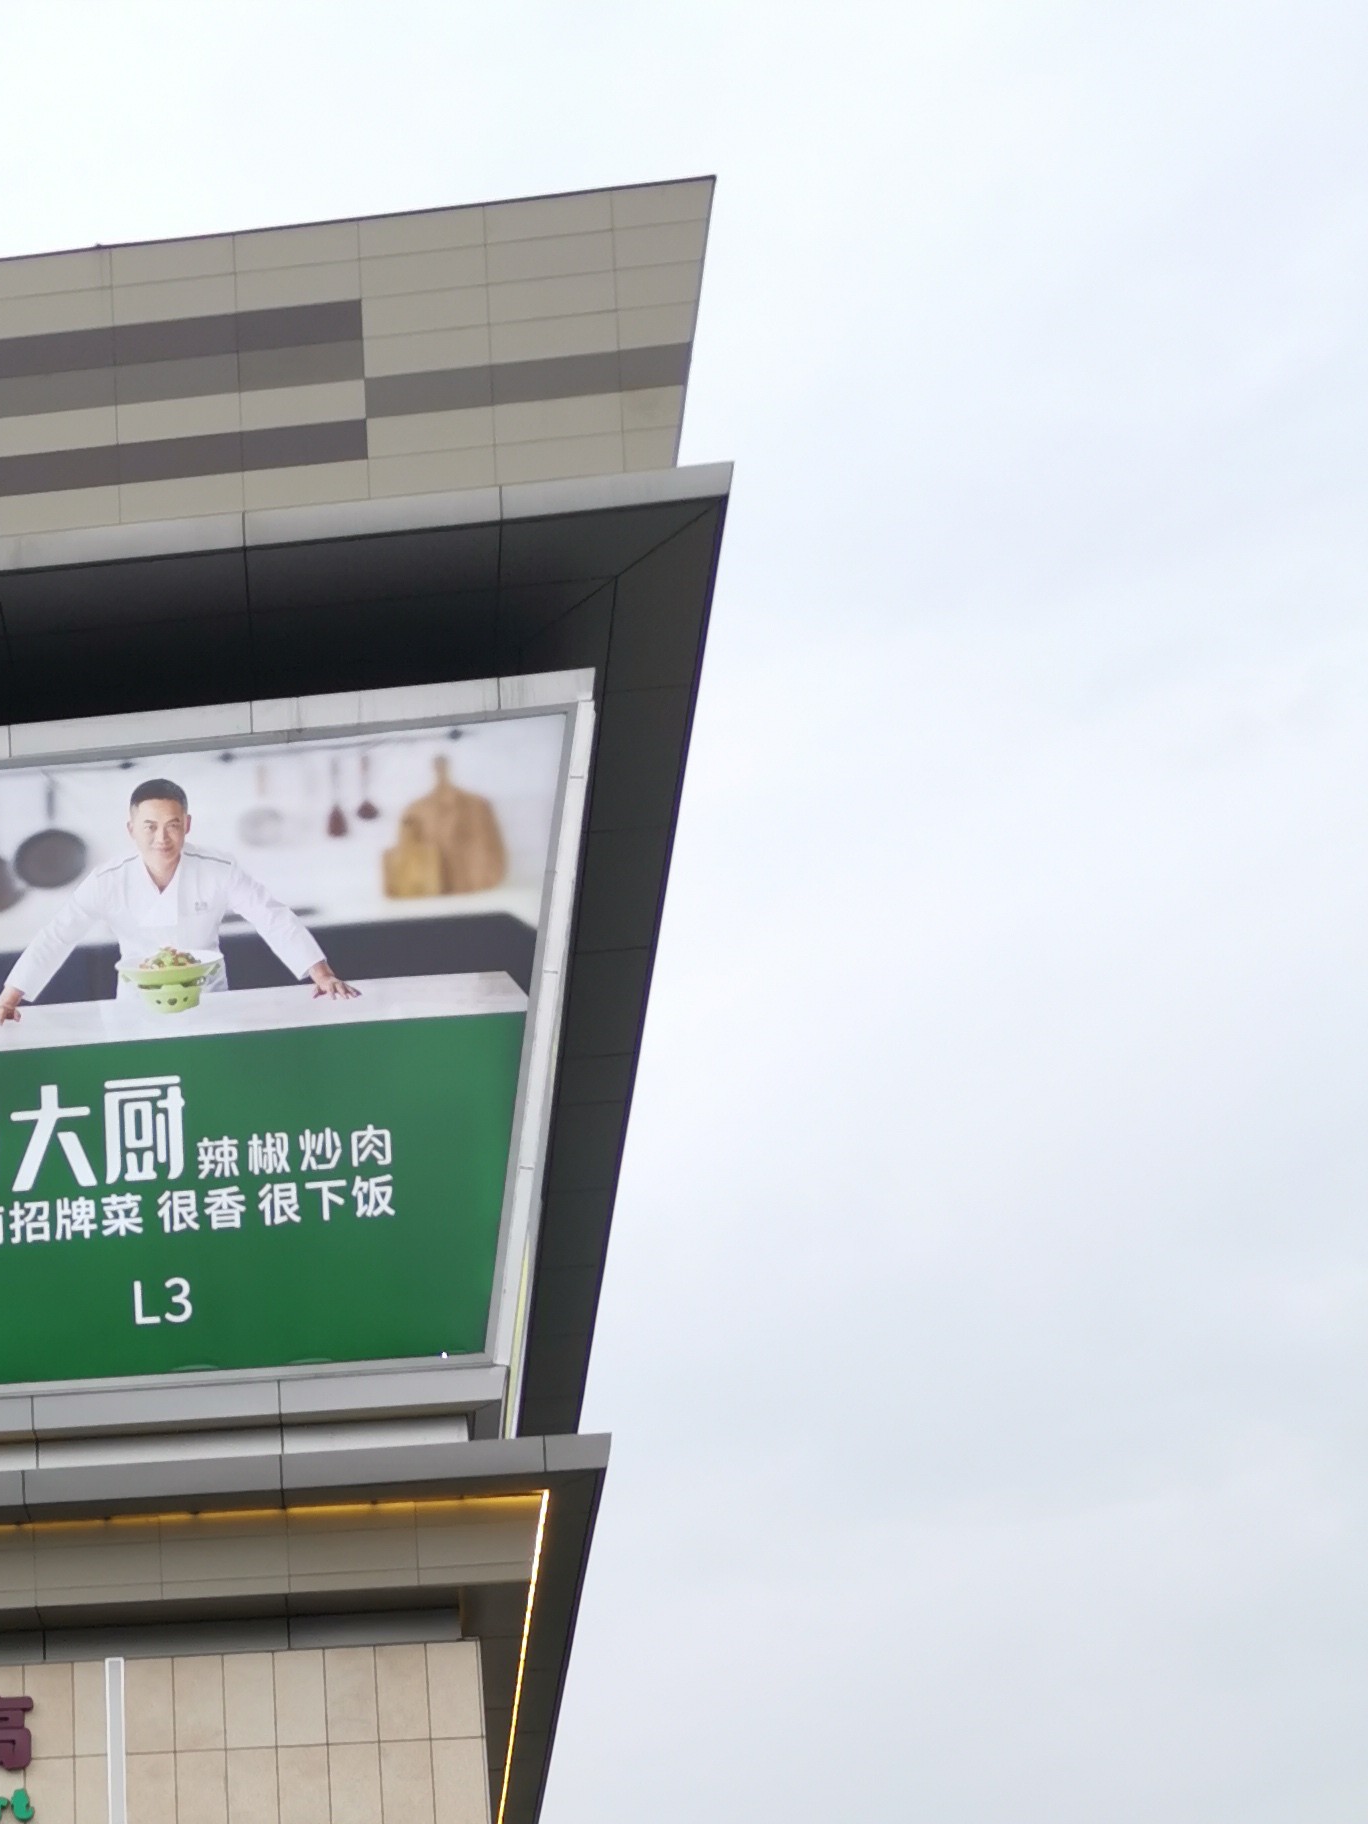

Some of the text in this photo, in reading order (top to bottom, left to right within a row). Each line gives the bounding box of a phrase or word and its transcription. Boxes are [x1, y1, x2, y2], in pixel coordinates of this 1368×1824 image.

[197, 1124, 392, 1180] 辣椒炒肉
[157, 1186, 246, 1234] 很香
[258, 1174, 395, 1226] 很下饭
[131, 1277, 194, 1325] L3
